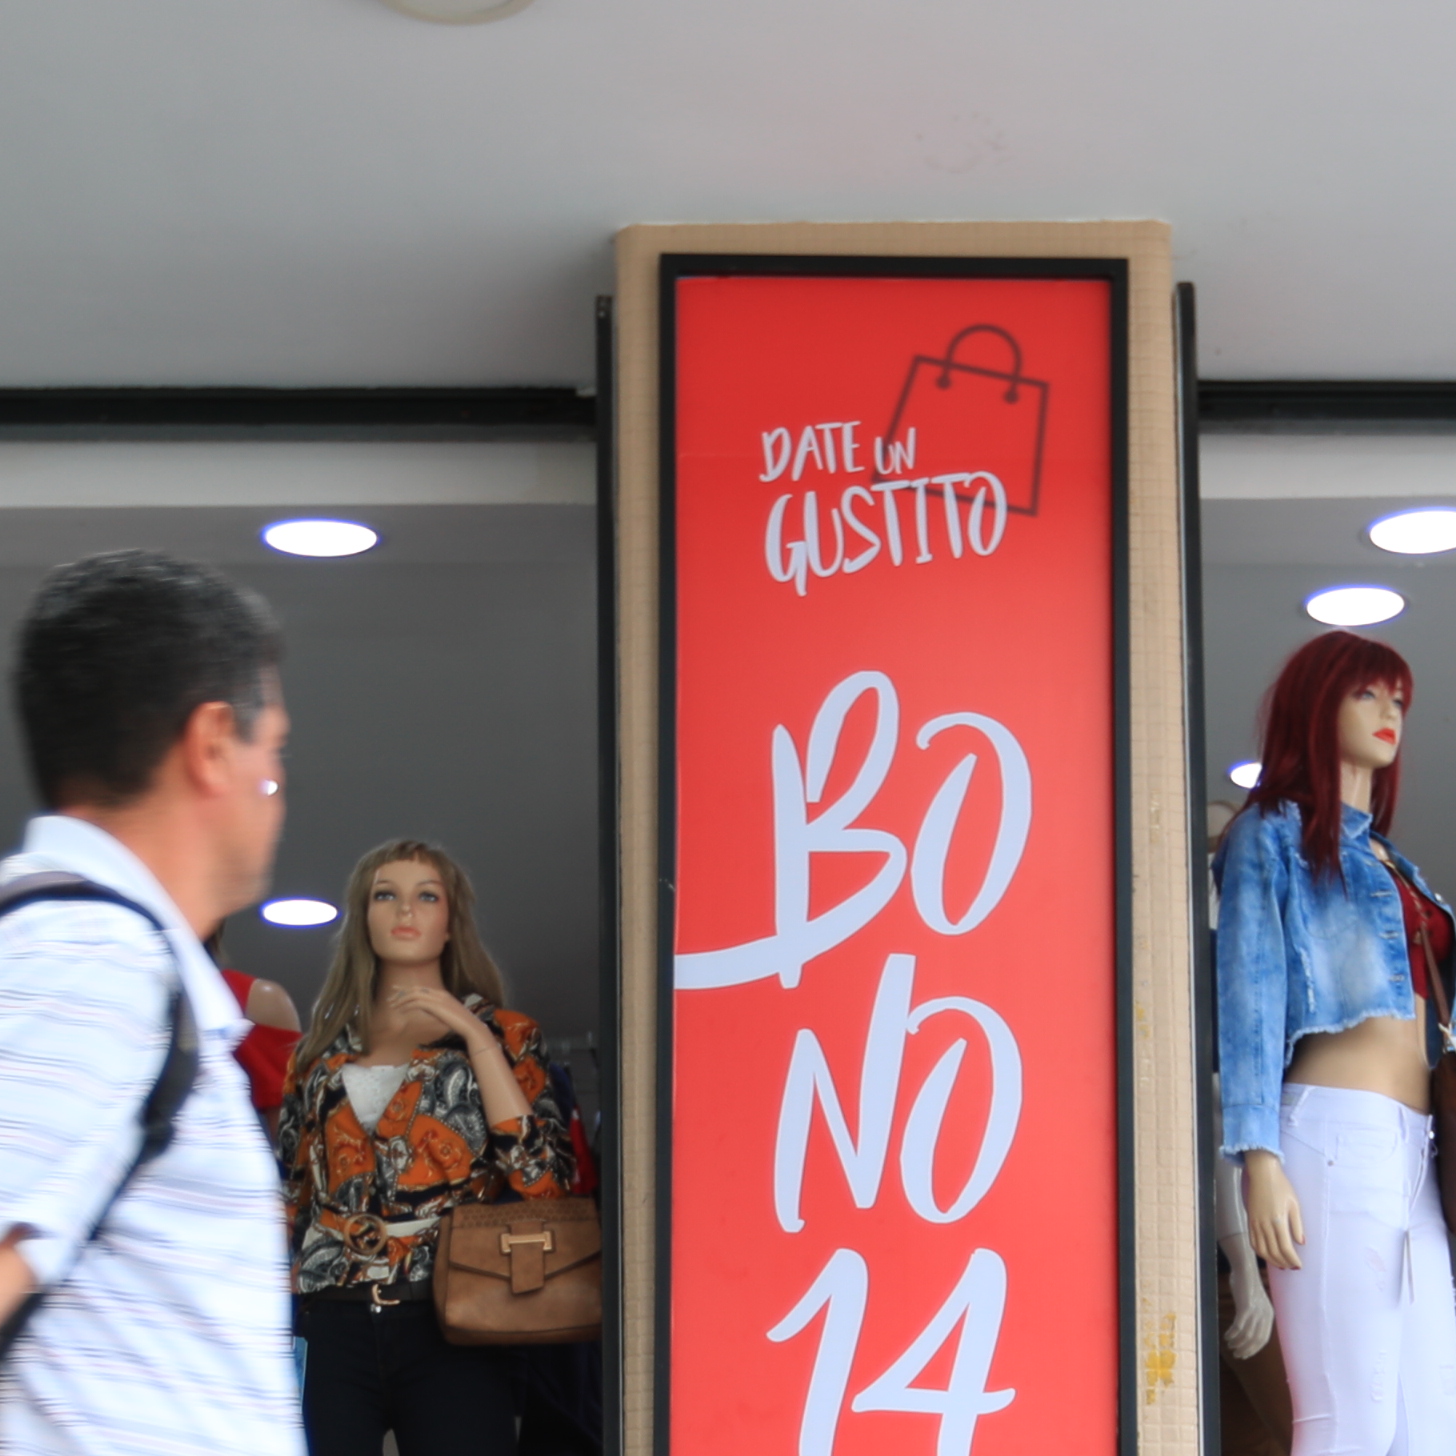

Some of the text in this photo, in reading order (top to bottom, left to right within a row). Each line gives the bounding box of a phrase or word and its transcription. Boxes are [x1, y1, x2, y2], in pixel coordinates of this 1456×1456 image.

[759, 421, 917, 482] DATE UN
[764, 471, 1008, 596] GUSTITO
[674, 670, 1033, 989] BO
[774, 953, 1023, 1234] NO
